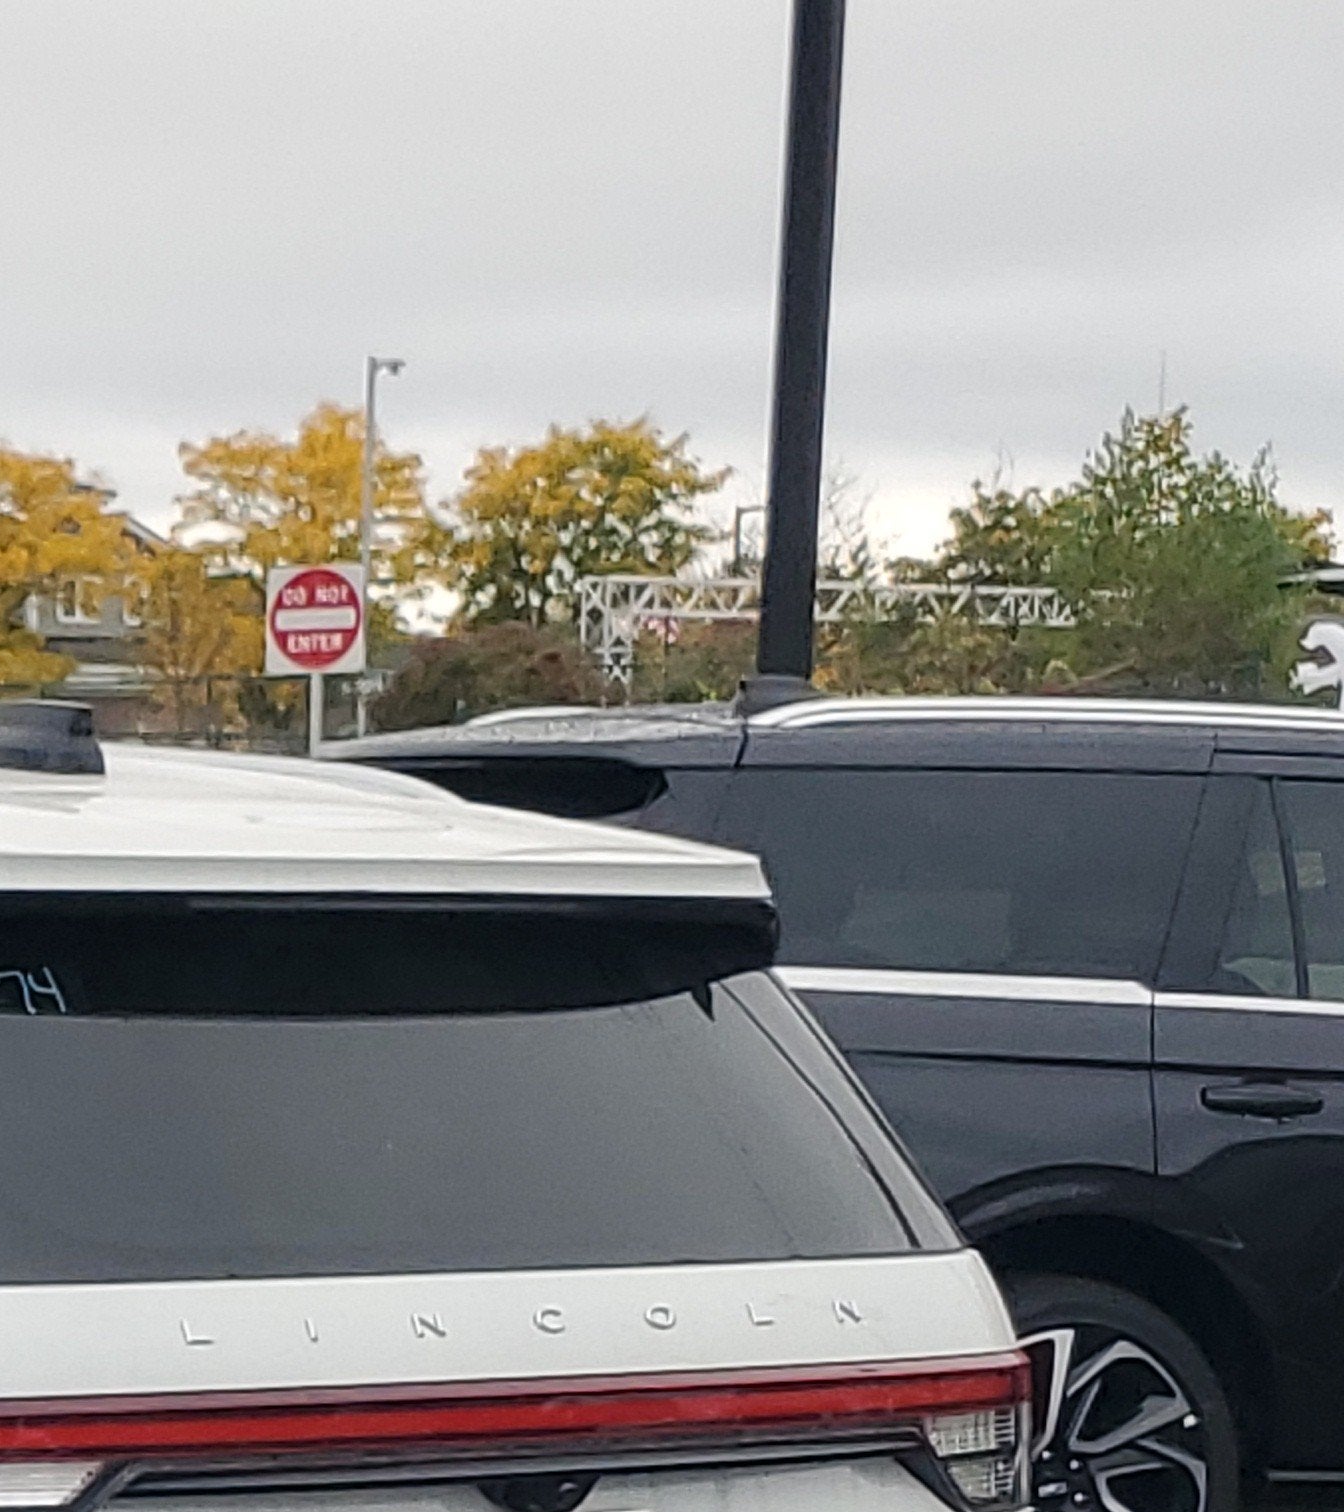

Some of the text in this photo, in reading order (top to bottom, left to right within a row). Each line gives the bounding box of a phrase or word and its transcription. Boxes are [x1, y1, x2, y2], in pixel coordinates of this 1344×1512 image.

[282, 585, 350, 605] DO NOT
[287, 633, 344, 653] ENTER
[180, 1299, 863, 1347] LINCOLN
